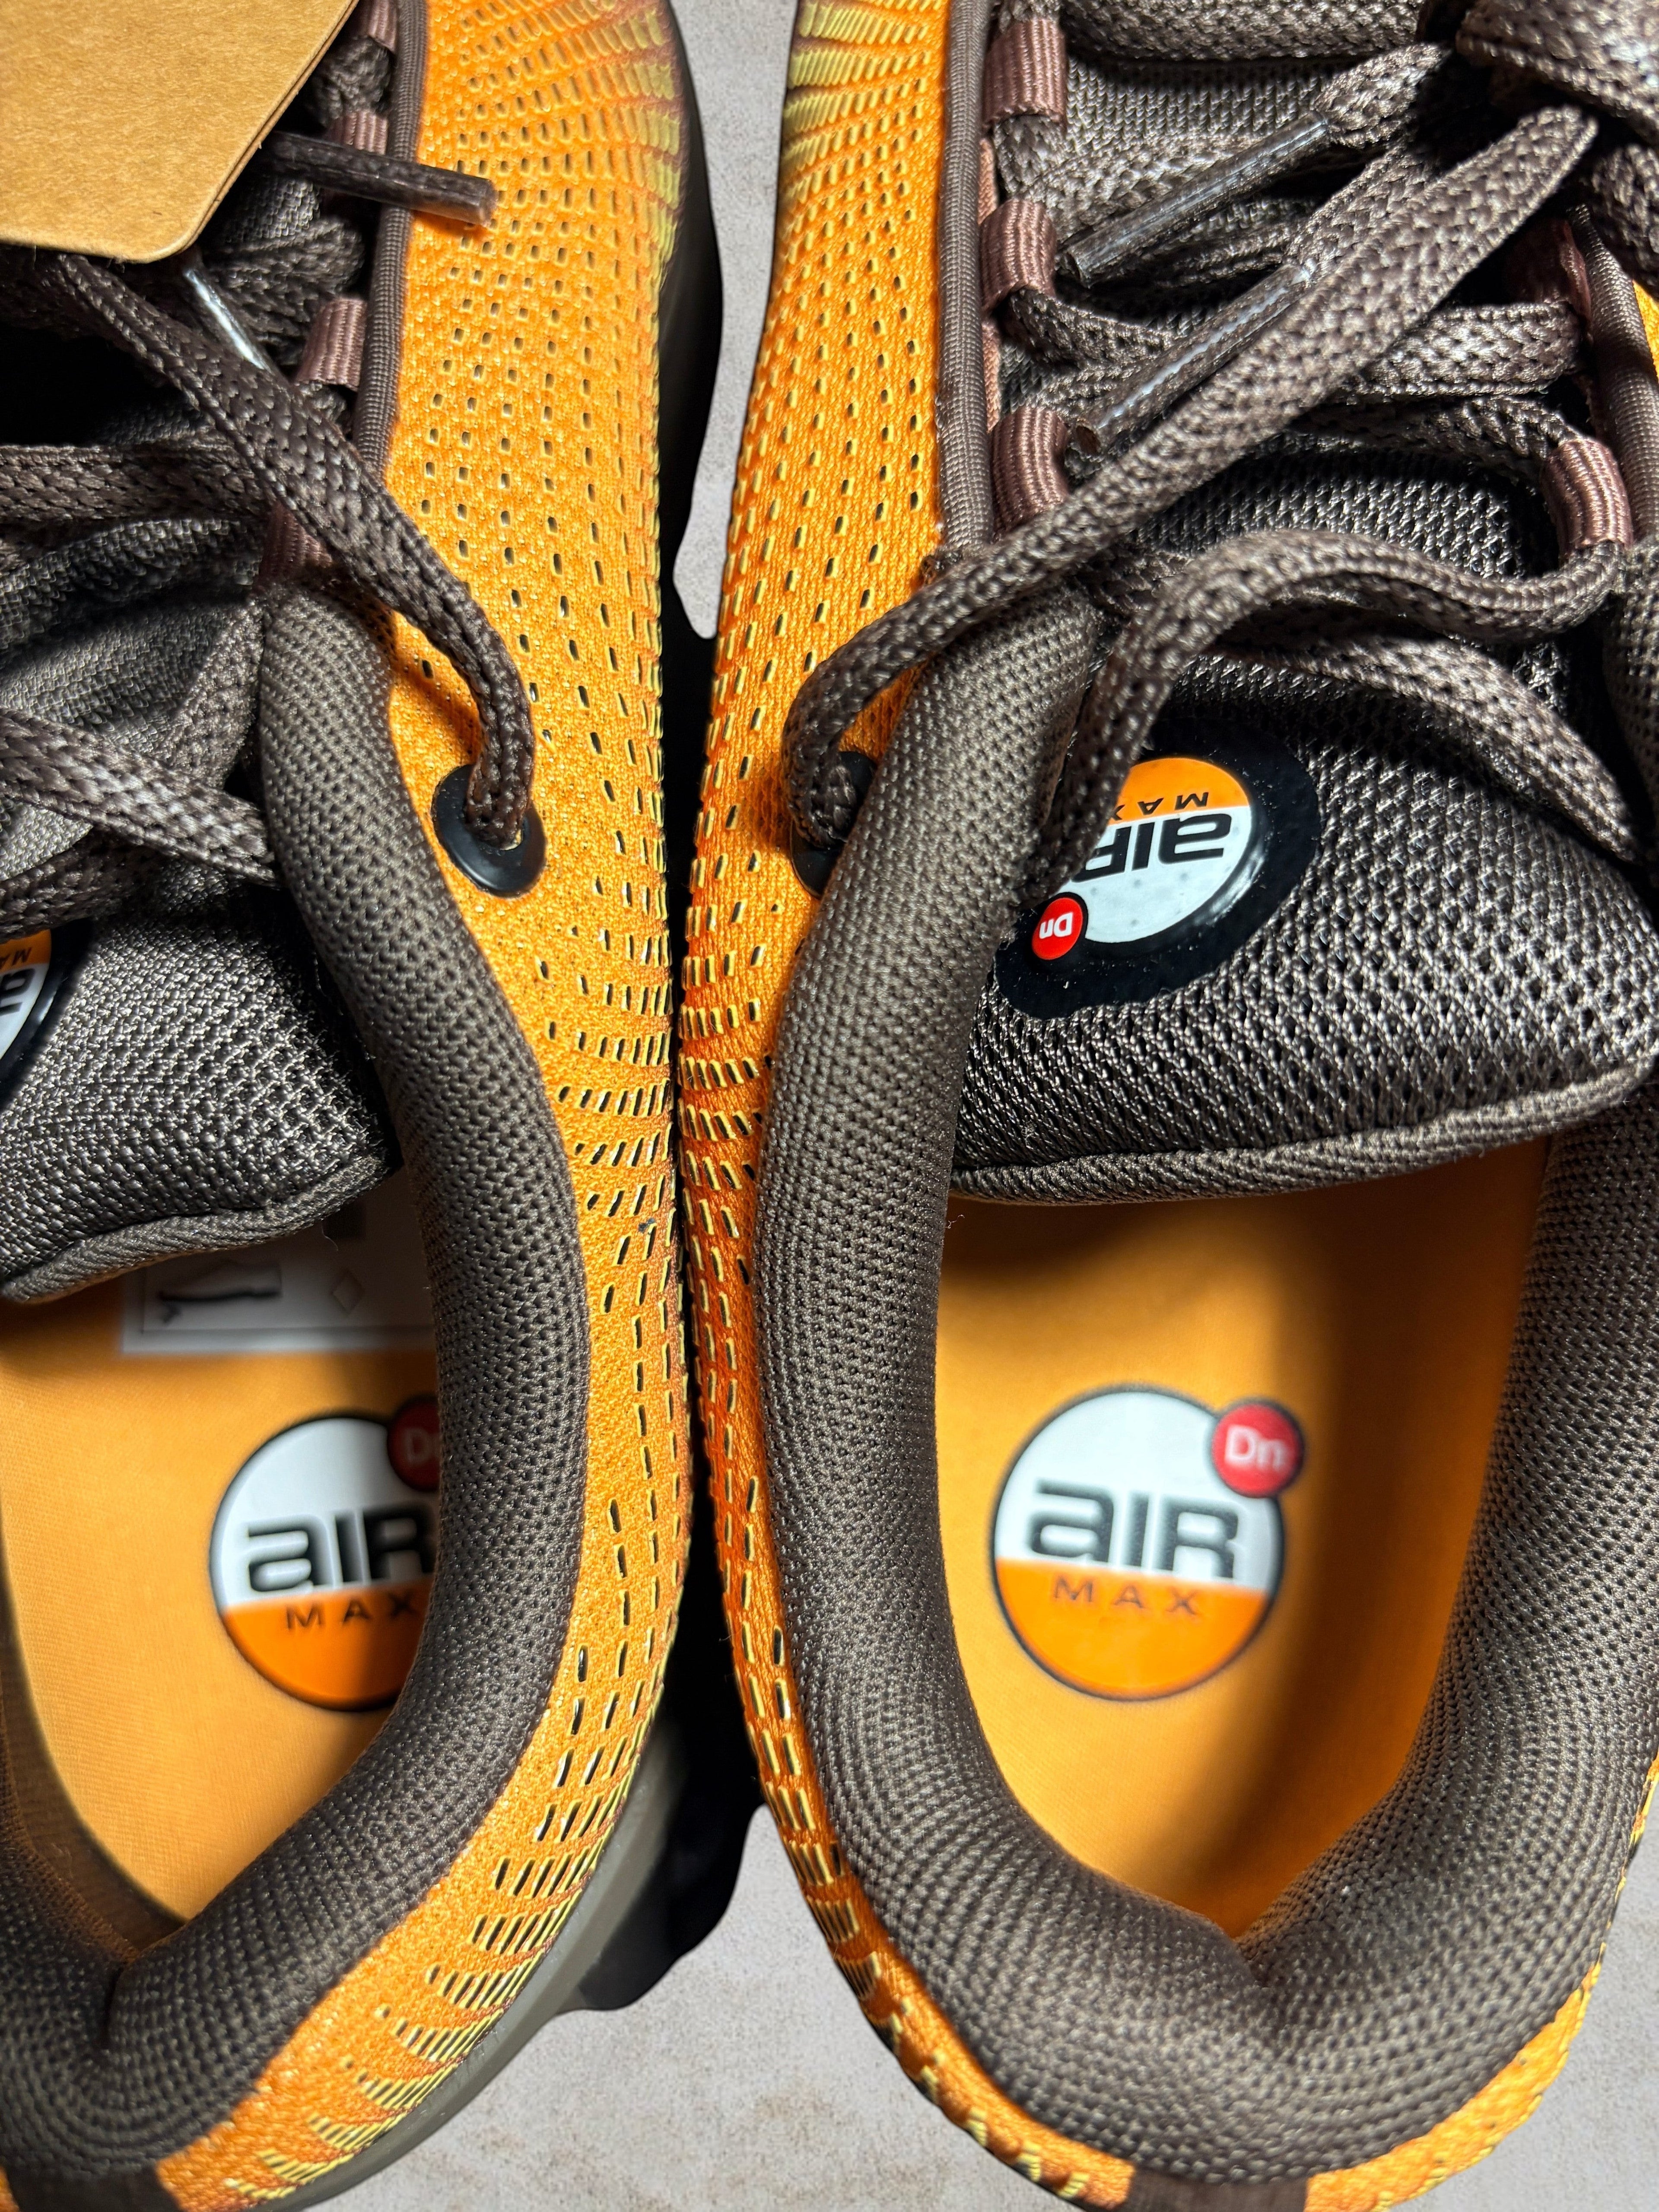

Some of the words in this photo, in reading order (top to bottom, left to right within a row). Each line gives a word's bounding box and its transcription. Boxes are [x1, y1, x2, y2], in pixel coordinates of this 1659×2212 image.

[1224, 1424, 1289, 1470] Dn
[286, 1591, 418, 1630] MAX
[1053, 1576, 1200, 1616] MAX
